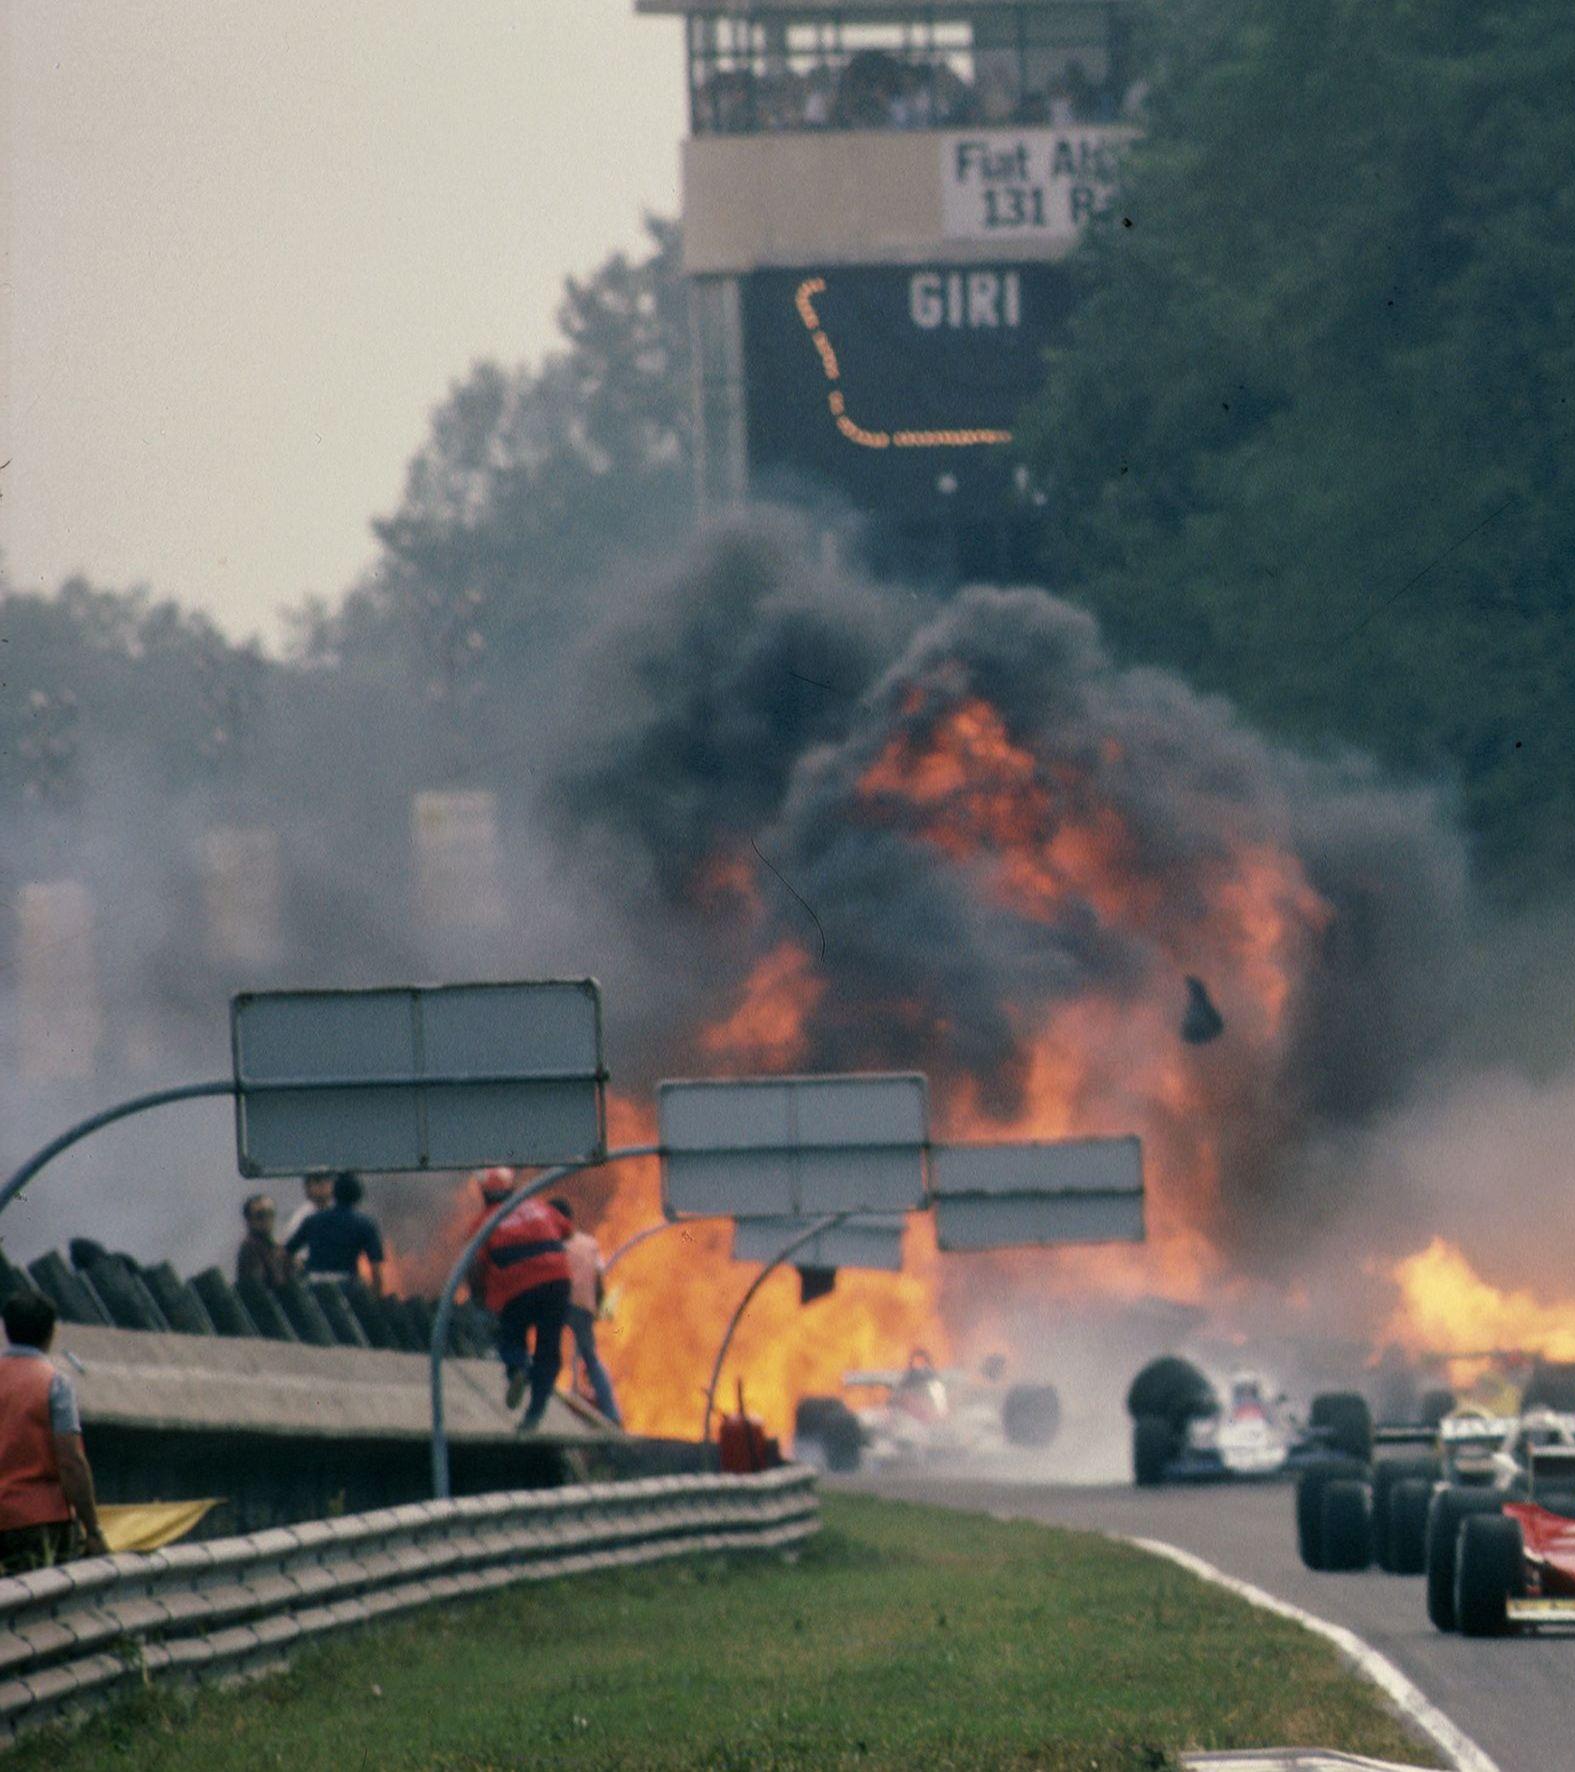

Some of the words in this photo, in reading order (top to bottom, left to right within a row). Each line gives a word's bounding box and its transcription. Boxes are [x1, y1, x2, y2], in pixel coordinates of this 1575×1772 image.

[956, 143, 1027, 183] Fiat
[984, 187, 1045, 228] 131
[910, 272, 1021, 329] GIRI
